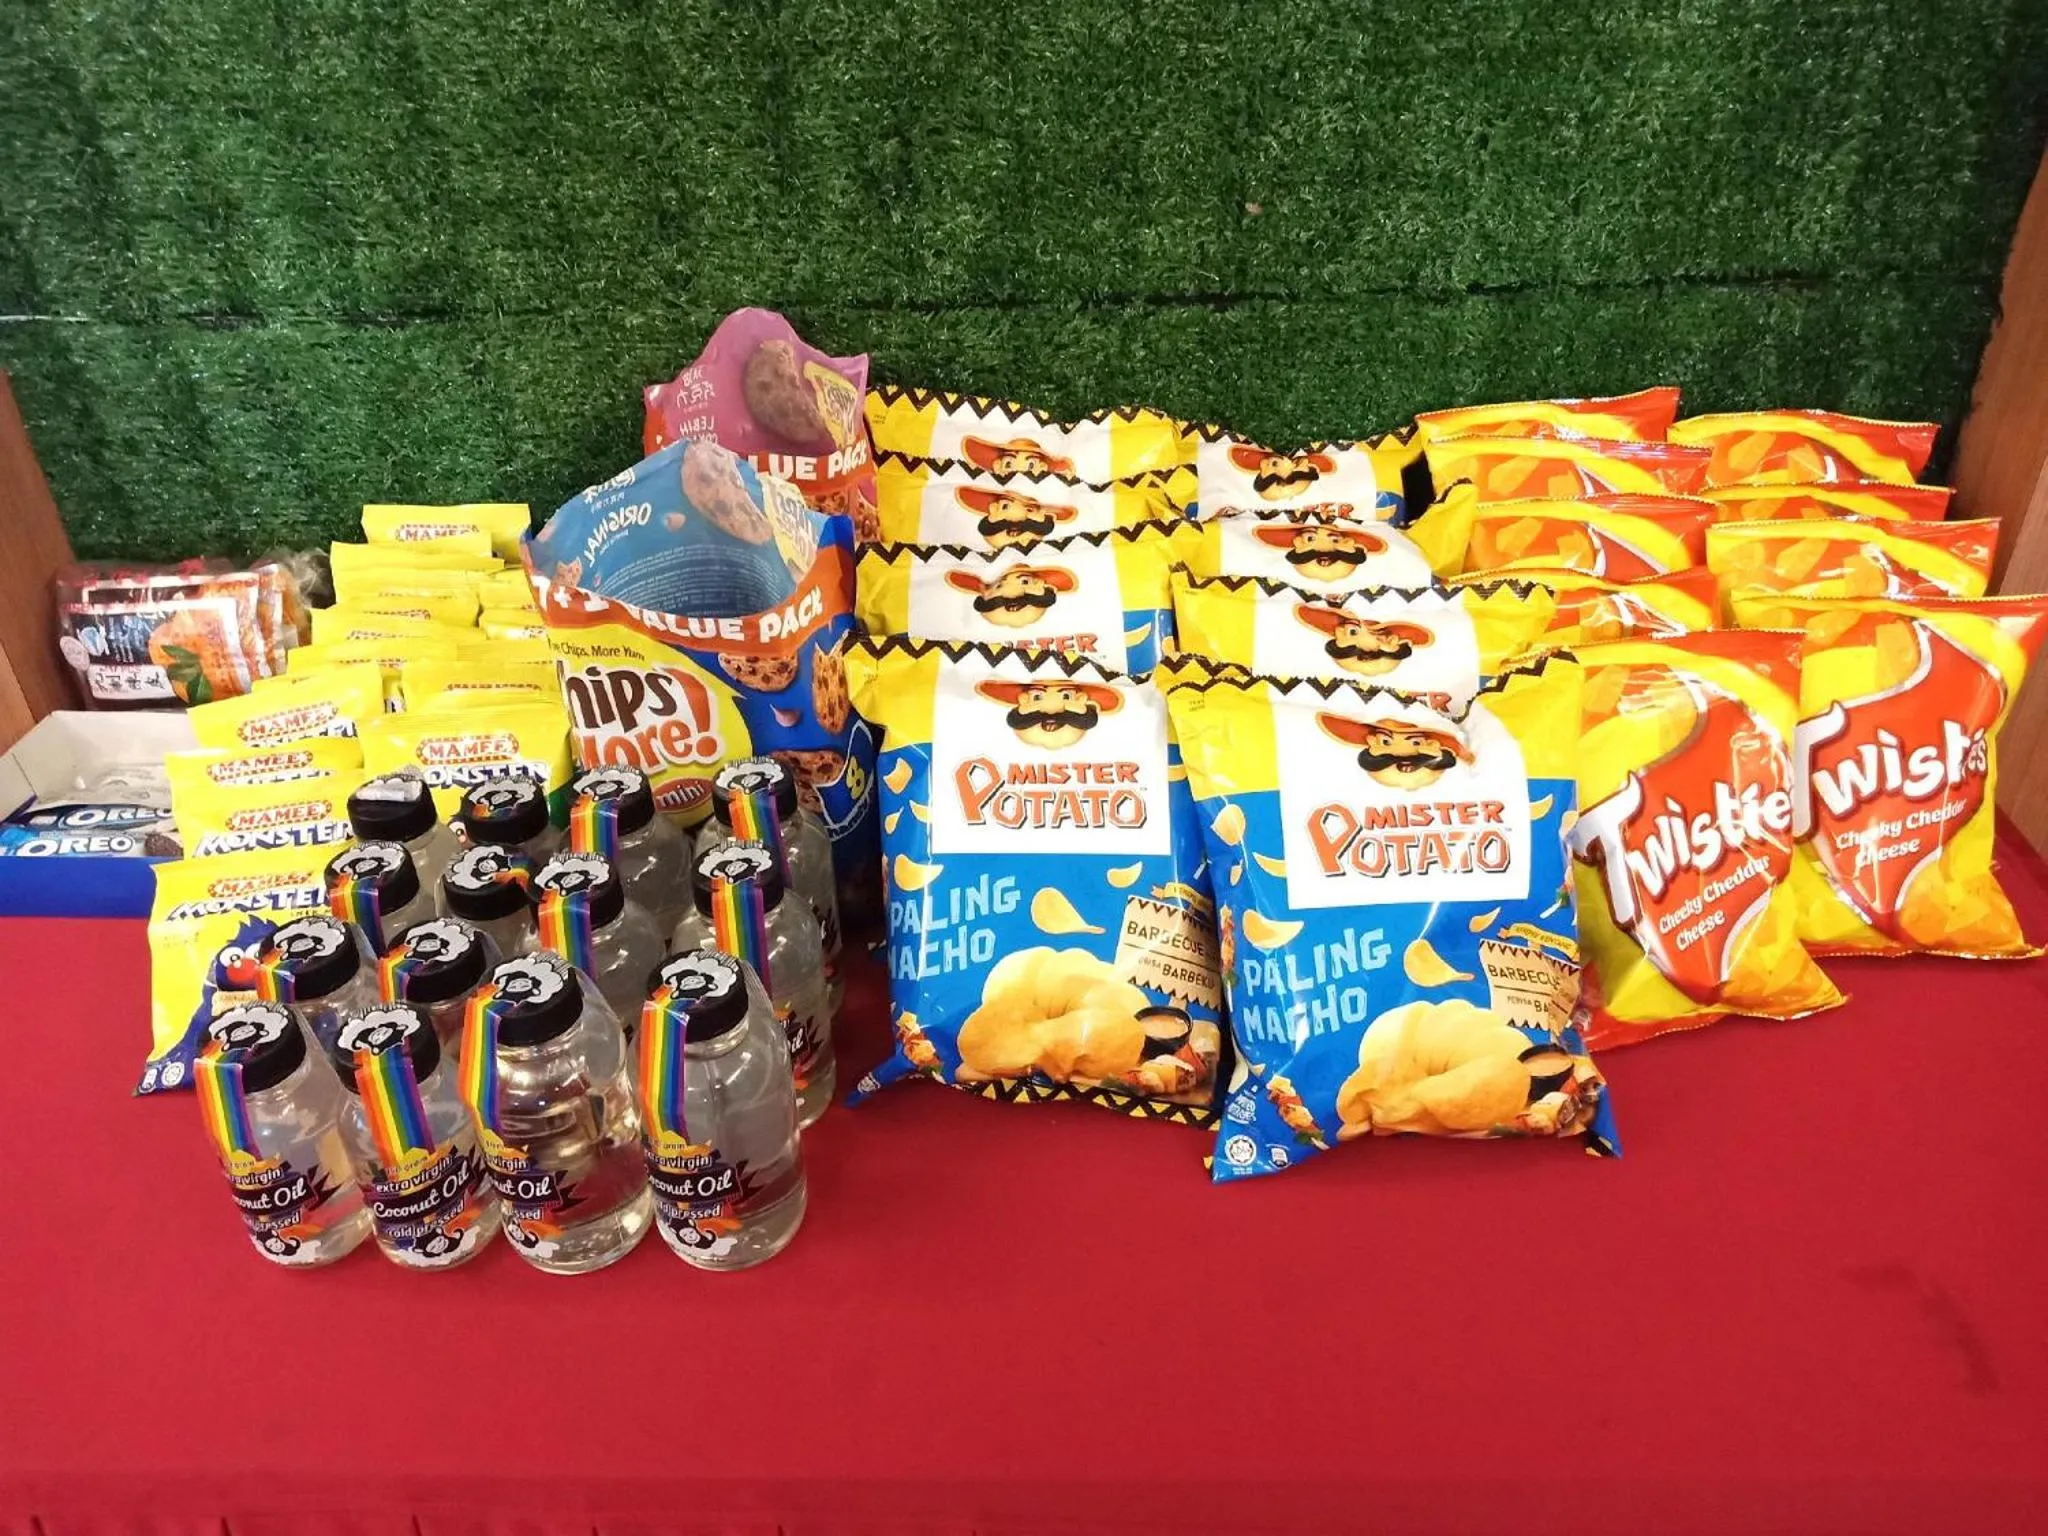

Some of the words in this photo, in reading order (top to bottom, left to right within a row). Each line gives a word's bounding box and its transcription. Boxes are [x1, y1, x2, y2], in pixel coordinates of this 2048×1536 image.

[747, 453, 817, 481] LUE
[827, 439, 868, 479] PACK
[758, 585, 823, 643] PACK
[590, 645, 620, 658] More
[556, 660, 678, 733] hips
[429, 738, 508, 758] MAMEE
[423, 761, 550, 790] ONSTER
[1006, 760, 1140, 786] MISTER
[1790, 700, 1987, 840] Twistes
[660, 780, 705, 808] mini
[952, 755, 1148, 829] POTATO
[238, 804, 320, 826] MAMEE
[1363, 800, 1506, 830] MISTER
[15, 835, 134, 856] OREO
[1305, 801, 1511, 878] POTATO
[1563, 770, 1793, 926] Twistie
[890, 873, 1021, 937] PALING
[1659, 894, 1705, 935] Cheeky
[1702, 855, 1770, 904] Cheddar
[1126, 920, 1205, 956] BARBECUE
[1676, 909, 1726, 952] Cheese
[1161, 963, 1216, 990] BARBEKU
[1242, 927, 1393, 998] PALING
[1487, 963, 1561, 991] BARBECUE
[1242, 983, 1368, 1044] MACHO
[375, 1180, 410, 1193] extra
[412, 1155, 453, 1184] virgin
[667, 1154, 710, 1170] virgin
[230, 1192, 273, 1210] onut
[274, 1176, 307, 1207] Oil
[373, 1188, 441, 1218] Coconut
[442, 1159, 470, 1198] Oil
[518, 1175, 552, 1199] Oil
[648, 1174, 696, 1197] oconut
[697, 1168, 733, 1197] Oil
